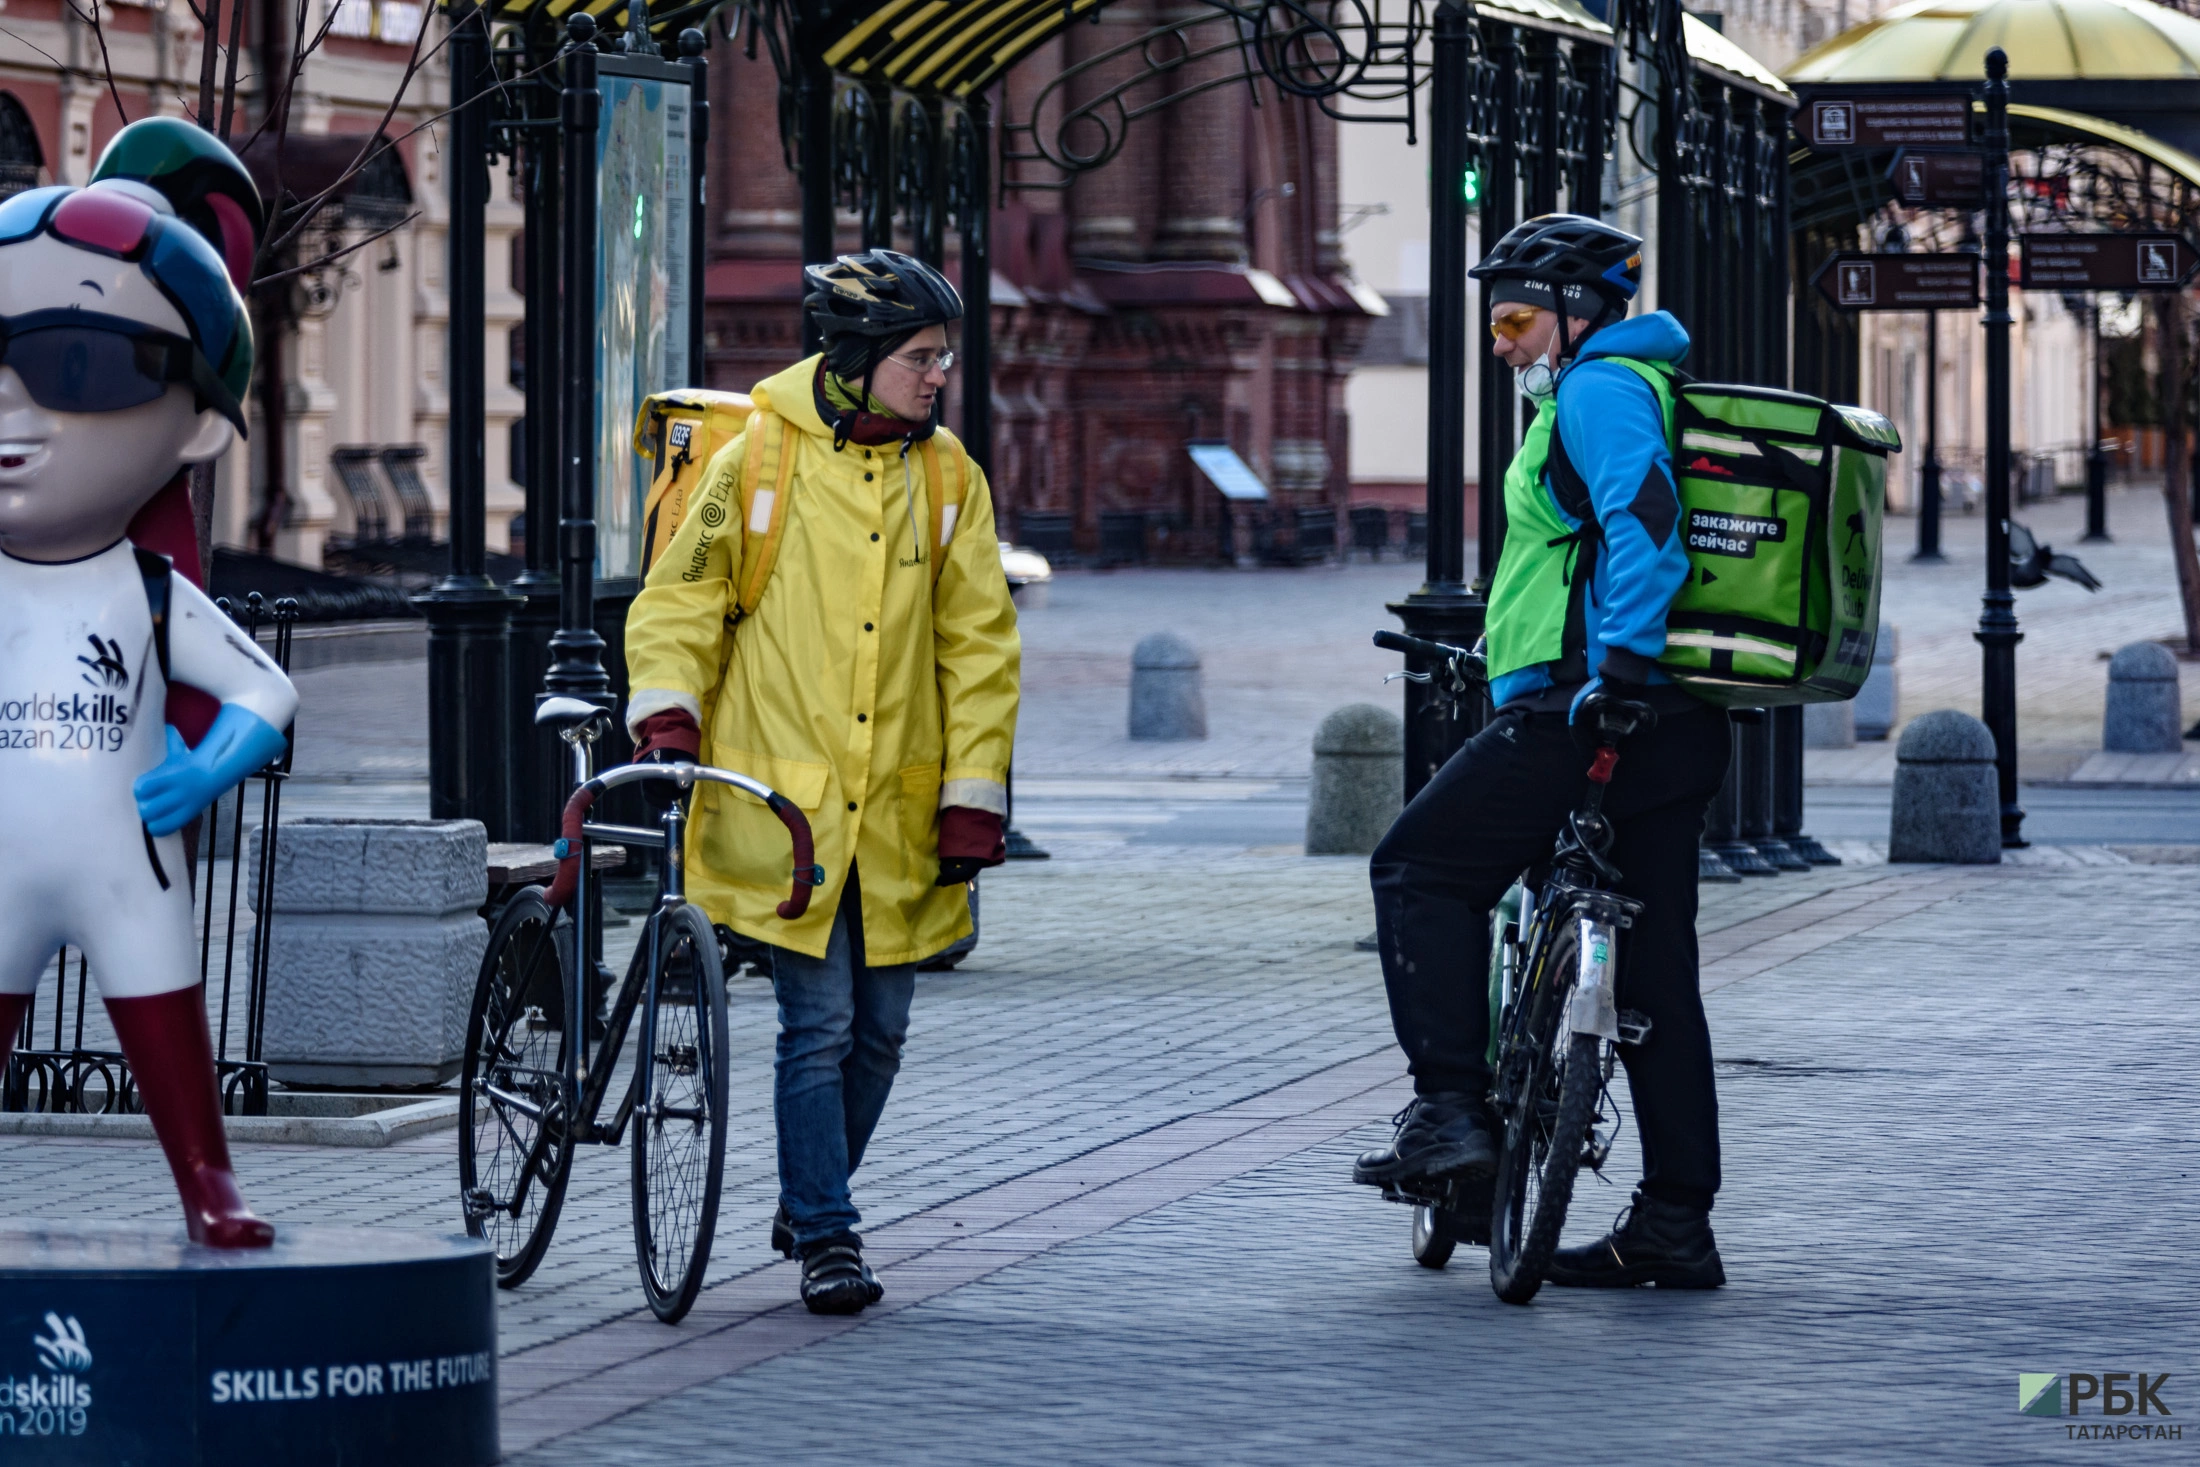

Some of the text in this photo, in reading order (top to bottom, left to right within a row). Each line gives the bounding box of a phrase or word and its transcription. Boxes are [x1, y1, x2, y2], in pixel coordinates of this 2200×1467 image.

[682, 472, 736, 583] Яндекс Еда
[1691, 514, 1778, 536] закажите
[1689, 532, 1748, 553] сейчас
[59, 723, 124, 753] 2019
[211, 1367, 320, 1403] SKILLS
[327, 1364, 385, 1398] FOR
[388, 1359, 433, 1393] THE
[18, 1406, 88, 1436] 2019
